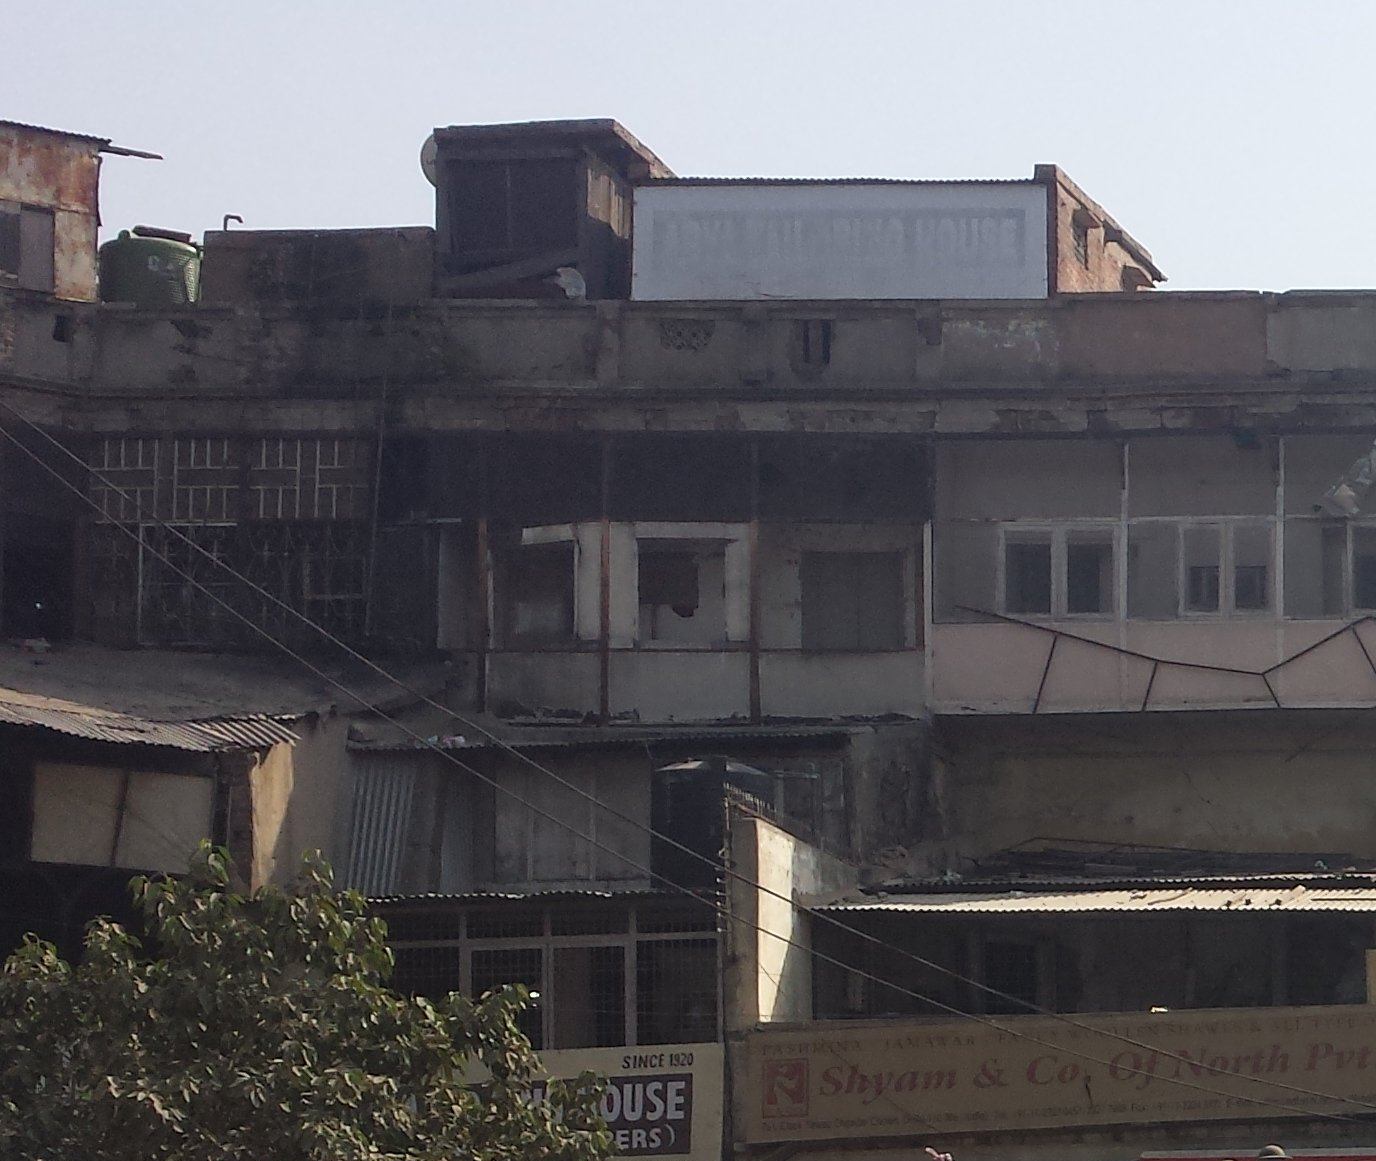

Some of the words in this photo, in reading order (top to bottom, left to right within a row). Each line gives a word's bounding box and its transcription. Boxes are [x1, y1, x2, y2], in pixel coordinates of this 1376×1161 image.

[622, 1053, 665, 1069] SINCE
[669, 1052, 694, 1067] 1920
[819, 1063, 957, 1105] Shyam
[973, 1058, 1009, 1090] &
[1109, 1050, 1159, 1090] Of
[1172, 1043, 1290, 1079] North
[592, 1081, 686, 1122] OUSE
